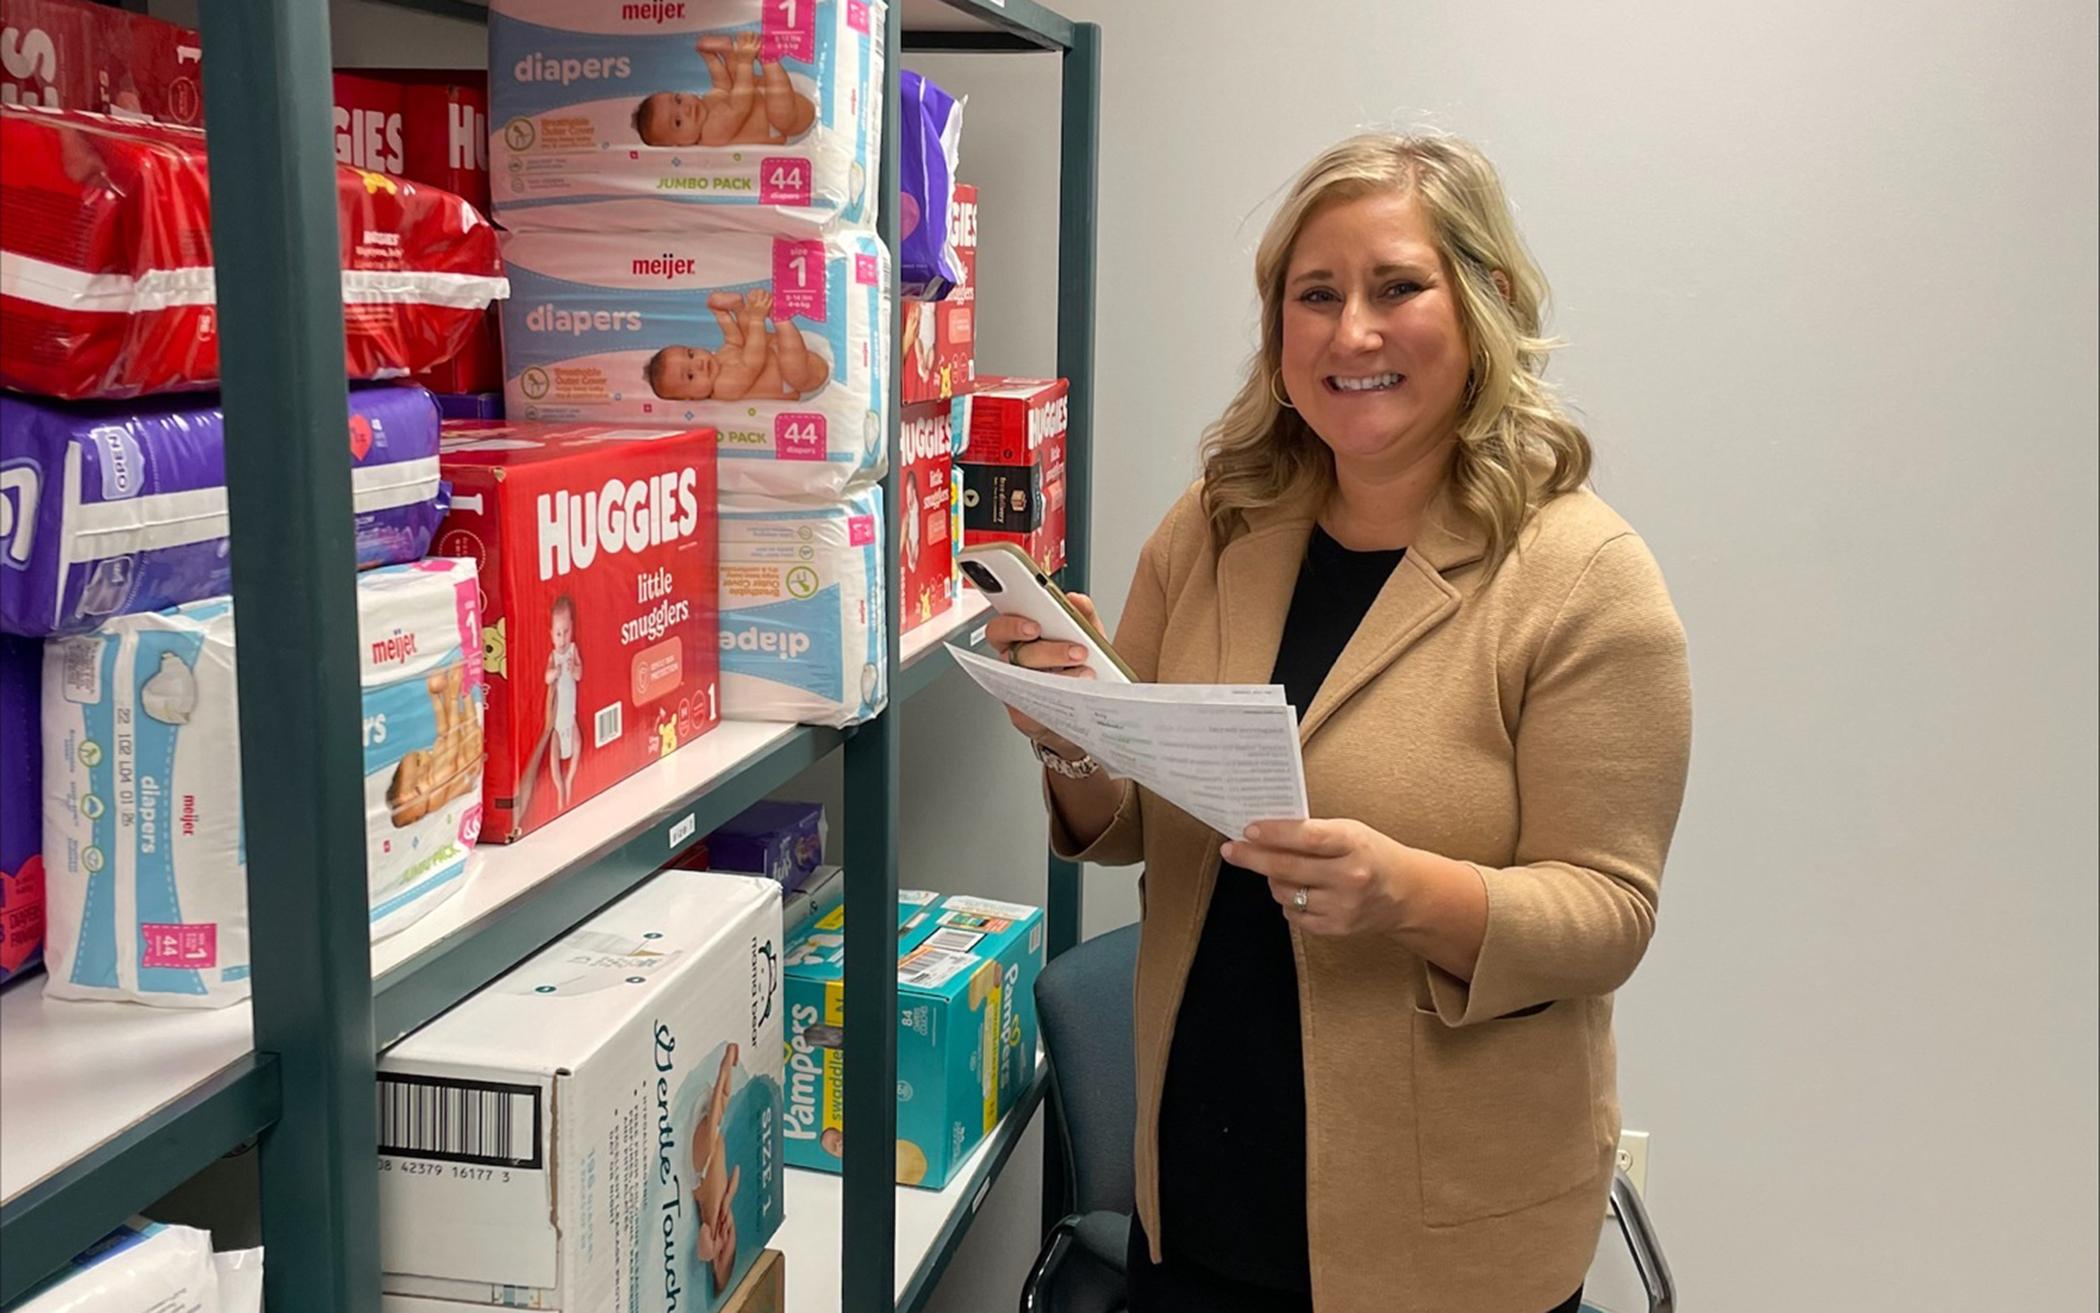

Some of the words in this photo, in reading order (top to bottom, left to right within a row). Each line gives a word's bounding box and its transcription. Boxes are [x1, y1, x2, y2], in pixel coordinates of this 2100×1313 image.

[622, 1, 684, 24] meijer
[514, 53, 631, 85] diapers
[656, 177, 709, 190] JUMBO
[712, 177, 752, 190] PACK
[769, 166, 803, 191] 44
[632, 253, 696, 280] meijer
[788, 255, 807, 288] 1
[526, 303, 642, 337] diapers
[554, 376, 579, 385] Outer
[581, 376, 608, 385] Cover
[729, 430, 767, 444] PACK
[783, 420, 818, 445] 44
[107, 432, 129, 491] OPEN
[538, 467, 698, 582] HUGGIES
[637, 566, 673, 604] little
[465, 610, 478, 649] 1
[620, 599, 690, 645] snugglers
[372, 629, 416, 664] meijer
[117, 708, 131, 724] 22
[707, 683, 717, 721] 1
[140, 775, 160, 854] diapers
[180, 795, 199, 836] meijer
[163, 934, 178, 956] 44
[184, 946, 208, 959] 1
[751, 1000, 759, 1049] bear
[900, 1010, 913, 1027] 84
[1001, 962, 1019, 1089] Pampers
[783, 1003, 822, 1140] Pampers
[653, 1018, 676, 1185] Gentle
[762, 1107, 773, 1190] SIZE
[400, 1161, 443, 1176] 42379
[451, 1166, 493, 1181] 16177
[501, 1170, 511, 1183] 3
[762, 1194, 773, 1218] 1
[662, 1174, 682, 1313] Touch
